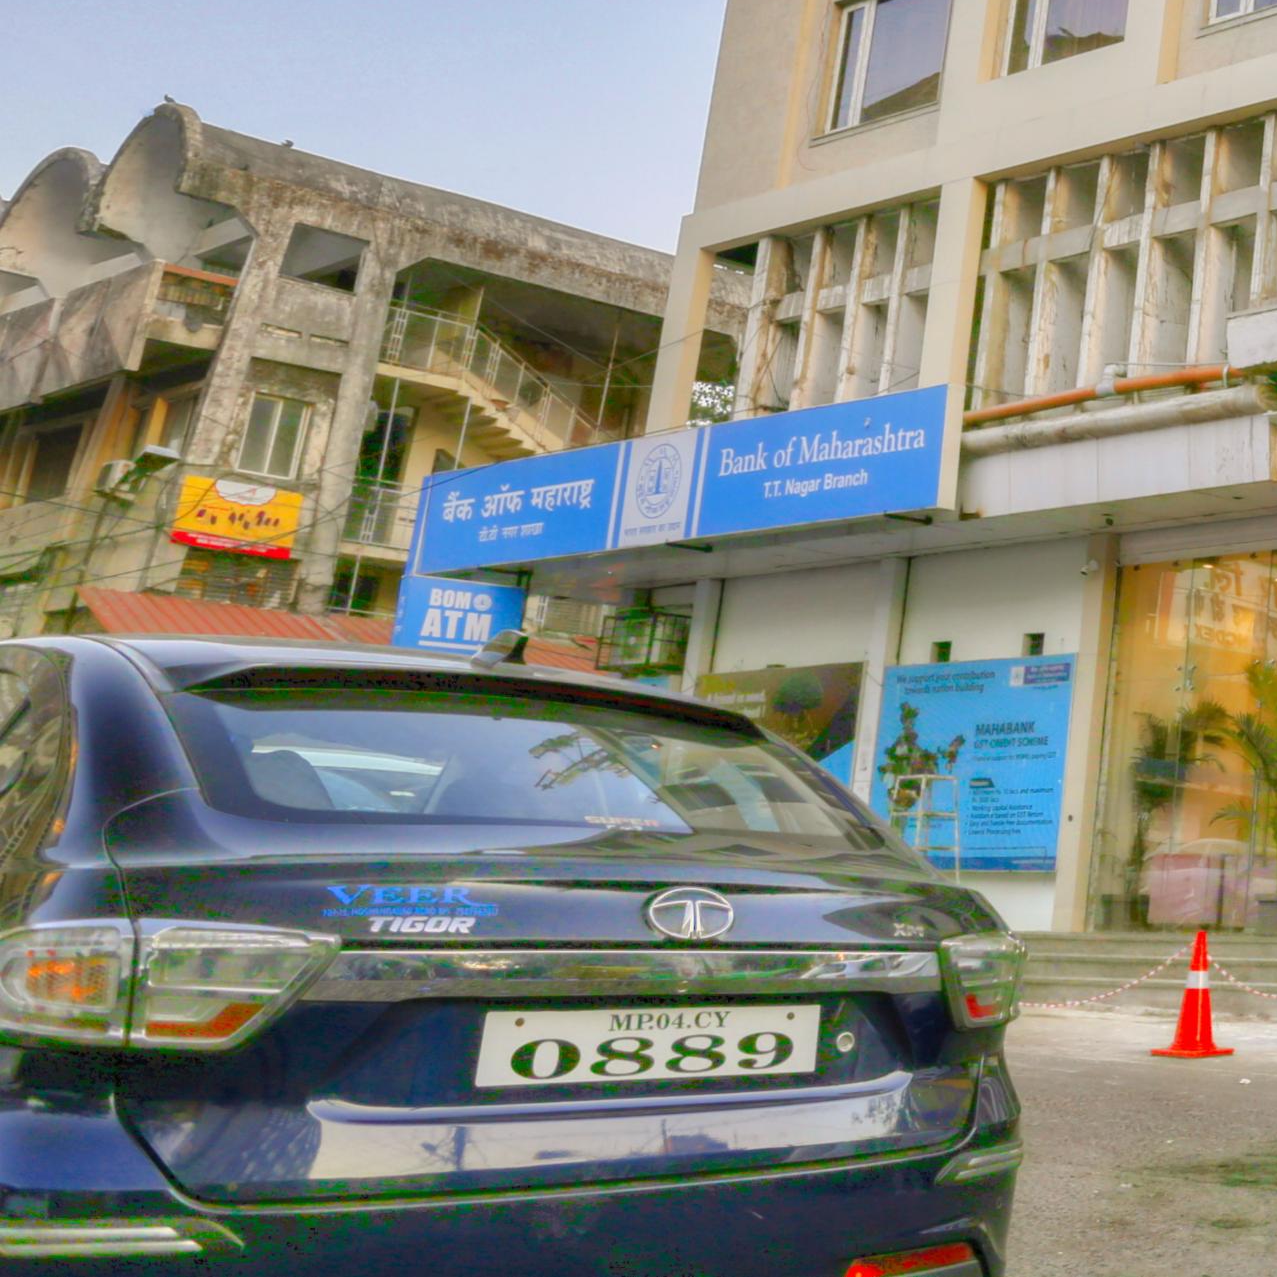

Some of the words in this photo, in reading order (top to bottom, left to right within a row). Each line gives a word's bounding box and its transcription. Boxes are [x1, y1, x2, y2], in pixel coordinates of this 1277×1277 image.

[718, 449, 766, 478] Bank
[773, 442, 793, 468] of
[798, 424, 925, 465] Maharashtra
[443, 491, 475, 522] बैंक
[481, 484, 525, 518] ऑफ
[530, 479, 595, 512] महाराष्ट्र
[764, 481, 782, 500] T.T.
[785, 476, 820, 498] Nagar
[824, 468, 868, 490] Branch
[429, 588, 472, 610] BOM
[420, 608, 492, 642] ATM
[327, 883, 498, 908] VEER
[368, 916, 476, 934] TIGOR
[510, 1030, 795, 1081] 0889
